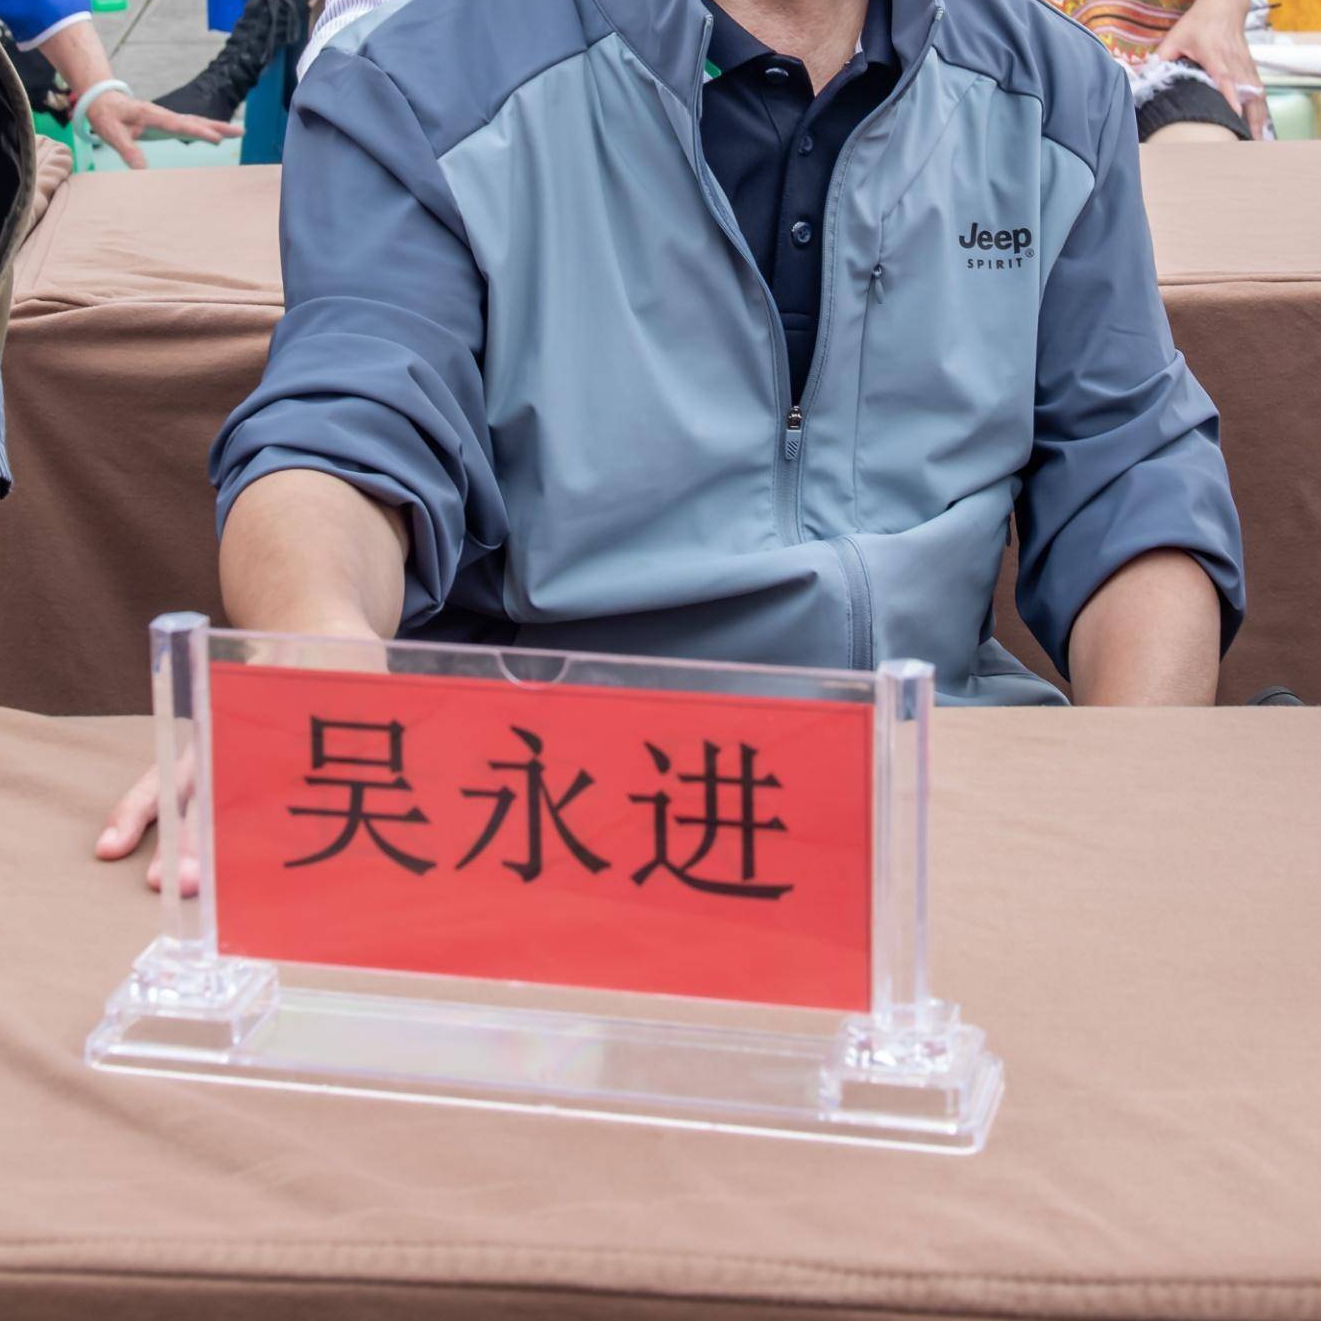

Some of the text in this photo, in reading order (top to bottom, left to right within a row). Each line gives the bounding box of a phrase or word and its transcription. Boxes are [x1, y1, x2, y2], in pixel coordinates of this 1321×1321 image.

[958, 221, 1033, 255] Jeep
[967, 257, 1024, 270] SPIRIT
[283, 715, 795, 901] 吴永进
